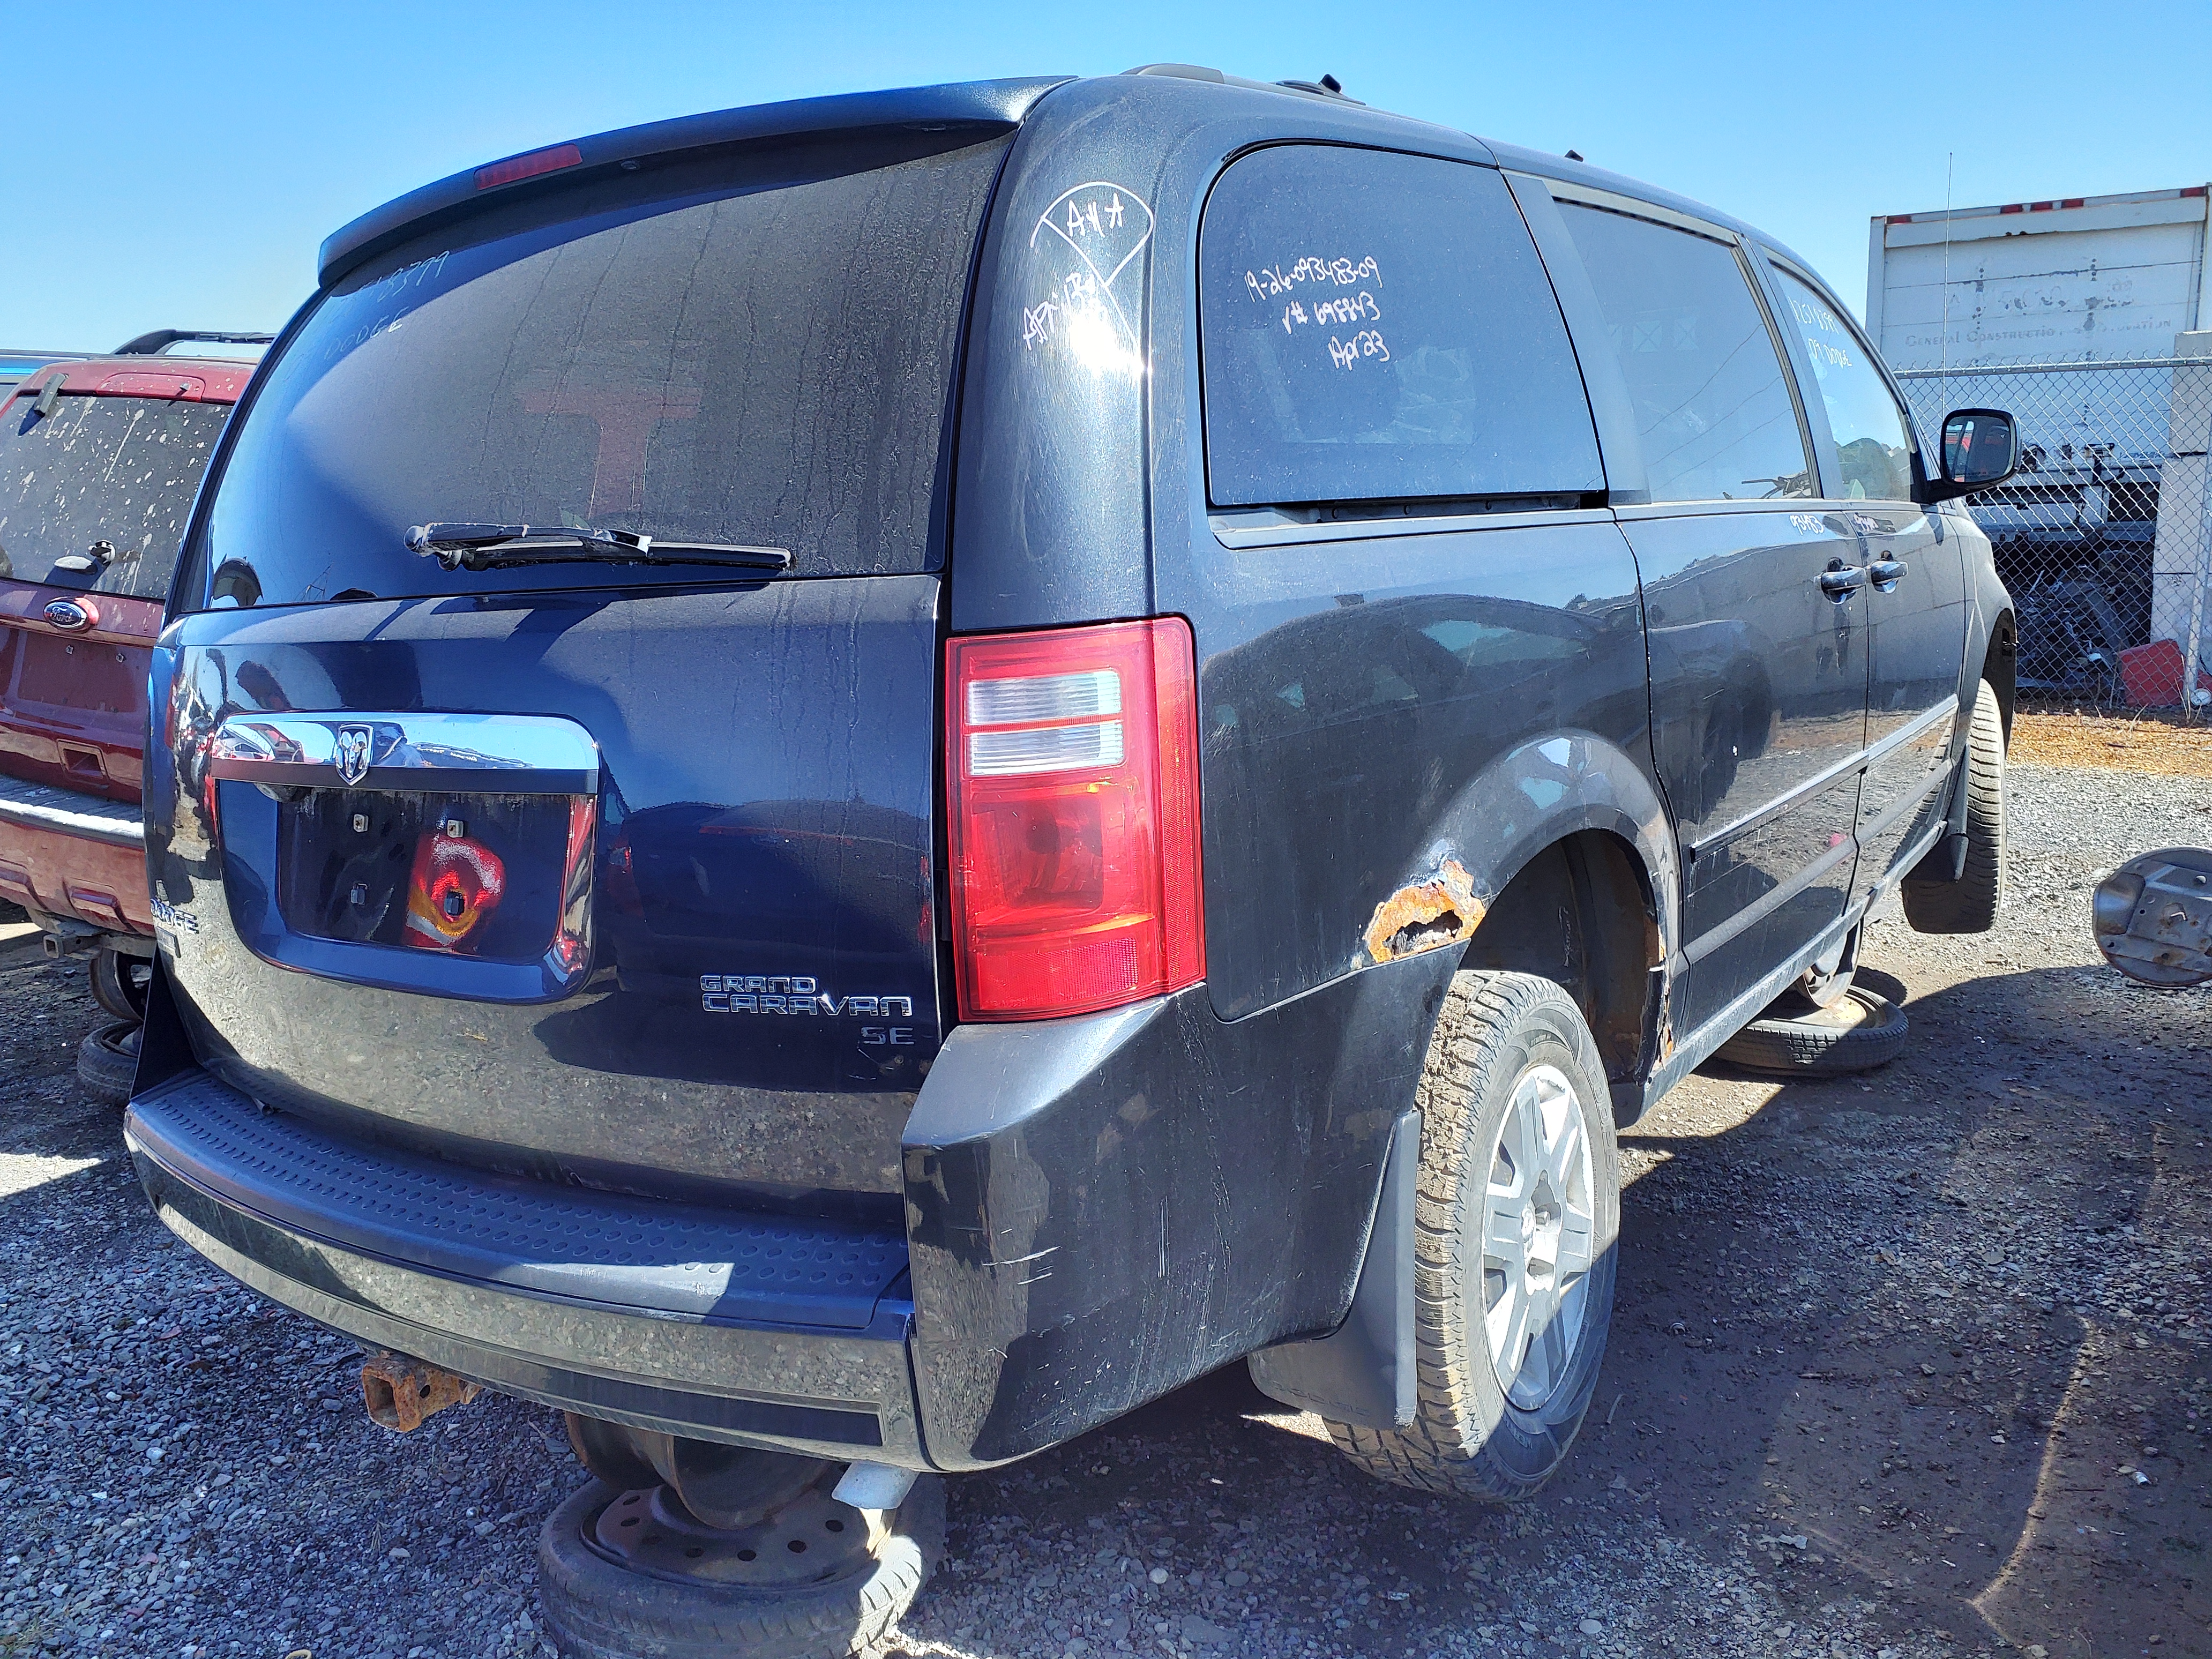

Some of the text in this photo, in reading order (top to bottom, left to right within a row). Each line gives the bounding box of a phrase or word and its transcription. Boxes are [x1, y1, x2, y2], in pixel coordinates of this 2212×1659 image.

[1790, 514, 1824, 535] 93483
[50, 606, 74, 623] Ford
[700, 974, 818, 993] GRAND
[701, 993, 913, 1017] CARAVAN
[861, 1026, 915, 1045] SE
